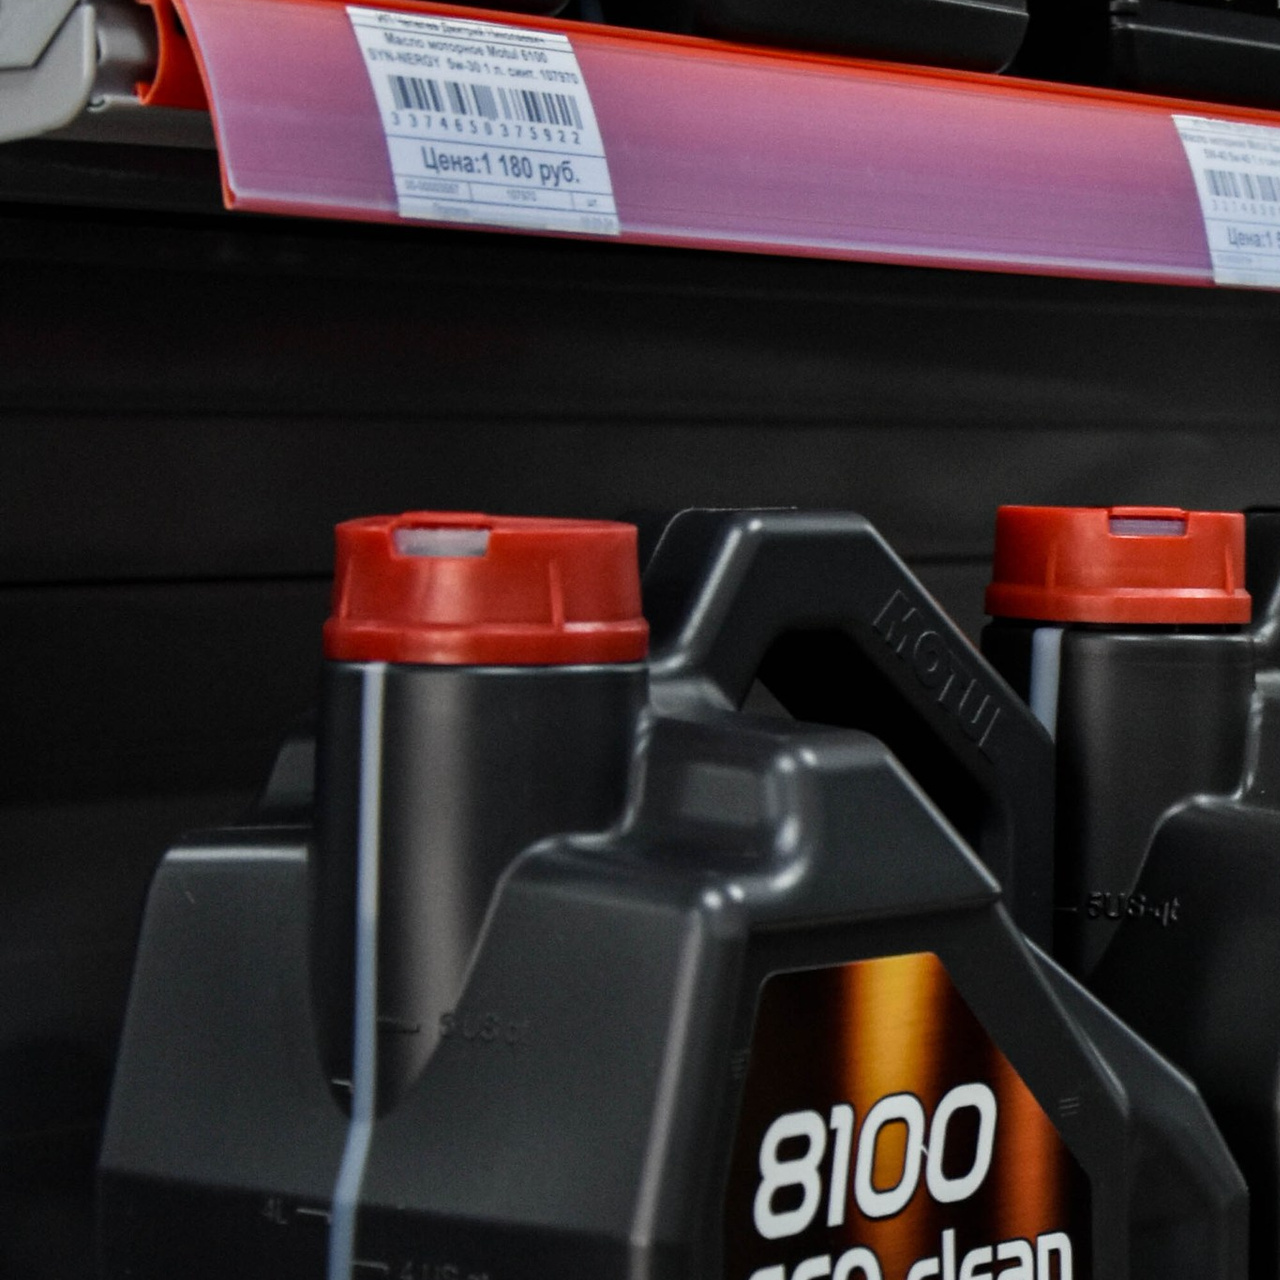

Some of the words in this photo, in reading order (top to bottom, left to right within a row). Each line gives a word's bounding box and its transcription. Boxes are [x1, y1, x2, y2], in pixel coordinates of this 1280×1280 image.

[384, 32, 425, 48] Масло
[428, 41, 484, 57] моторное
[486, 45, 519, 60] Motul
[422, 146, 491, 175] Цена:1
[498, 153, 533, 179] 180
[539, 160, 580, 187] руб.
[753, 1081, 998, 1240] 8100
